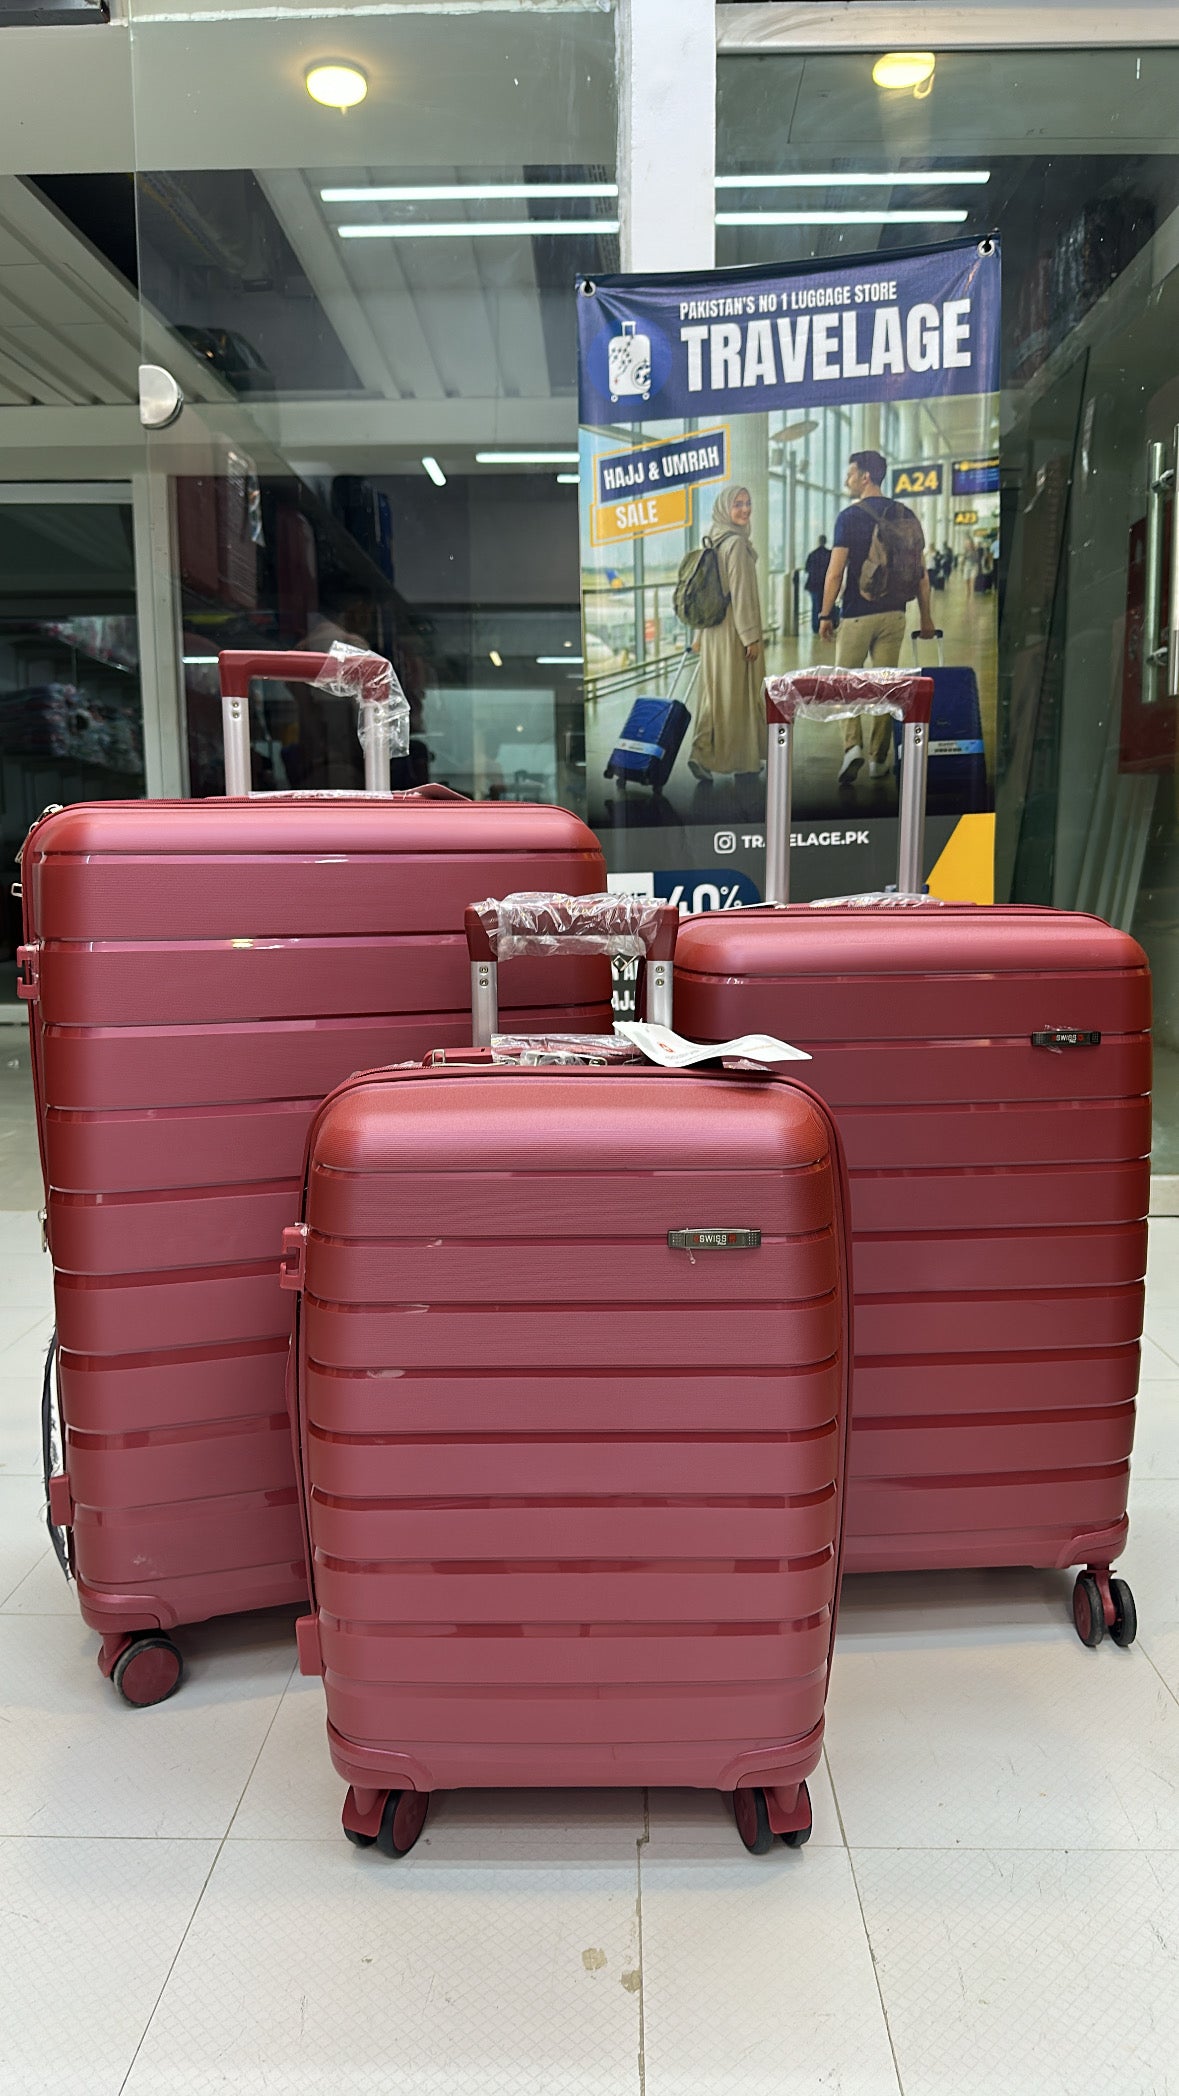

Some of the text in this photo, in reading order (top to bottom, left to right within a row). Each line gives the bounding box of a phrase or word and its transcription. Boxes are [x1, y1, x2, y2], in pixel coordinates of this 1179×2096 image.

[679, 281, 897, 320] PAKISTAN'S NO 1 LUGGAGE STORE
[680, 299, 971, 392] TRAVELAGE
[603, 446, 720, 490] HAJJ & UMRAH
[895, 470, 939, 494] A24
[615, 500, 658, 529] SALE
[741, 830, 870, 849] TRELAGE.PK
[1056, 1034, 1077, 1042] SWISS
[699, 1234, 727, 1243] SWISS
